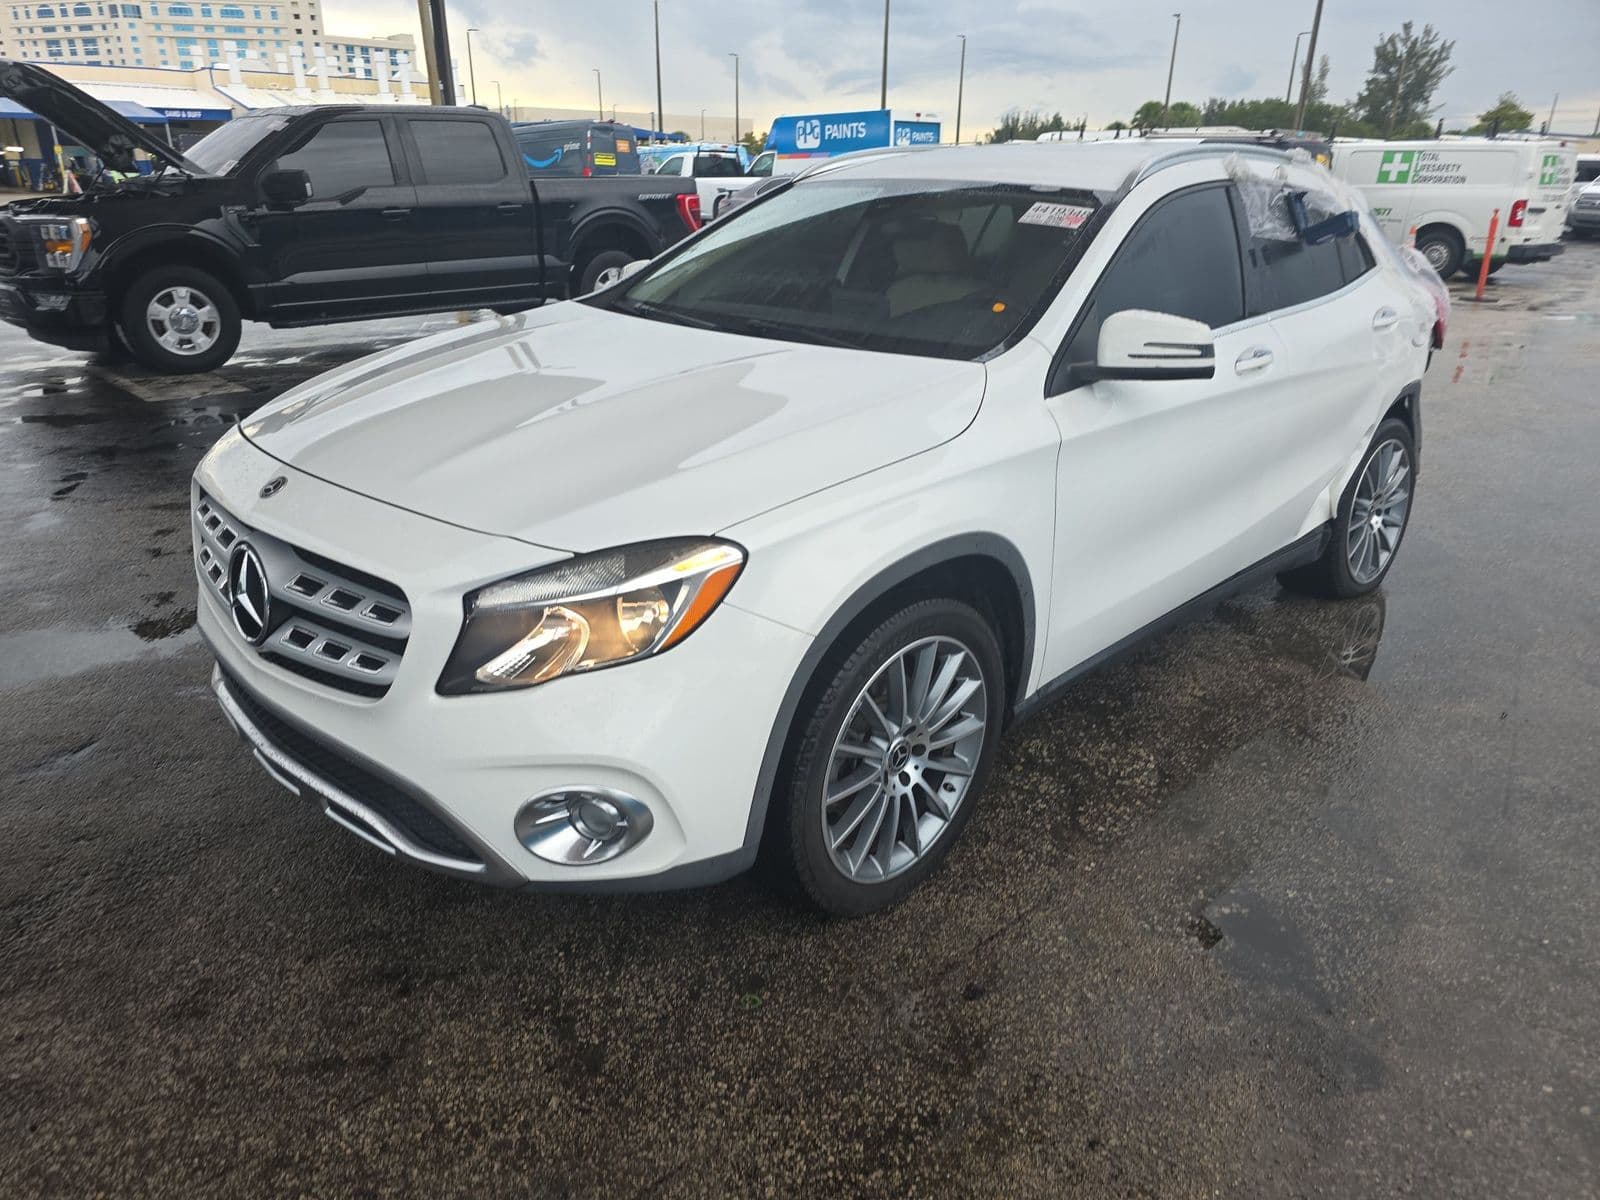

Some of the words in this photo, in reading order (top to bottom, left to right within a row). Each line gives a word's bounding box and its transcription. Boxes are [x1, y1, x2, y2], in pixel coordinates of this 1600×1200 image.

[797, 121, 820, 147] PPG
[825, 122, 867, 140] PAINTS
[912, 131, 934, 142] PAINTS
[563, 142, 581, 153] prime
[1411, 174, 1466, 184] CORPORATION
